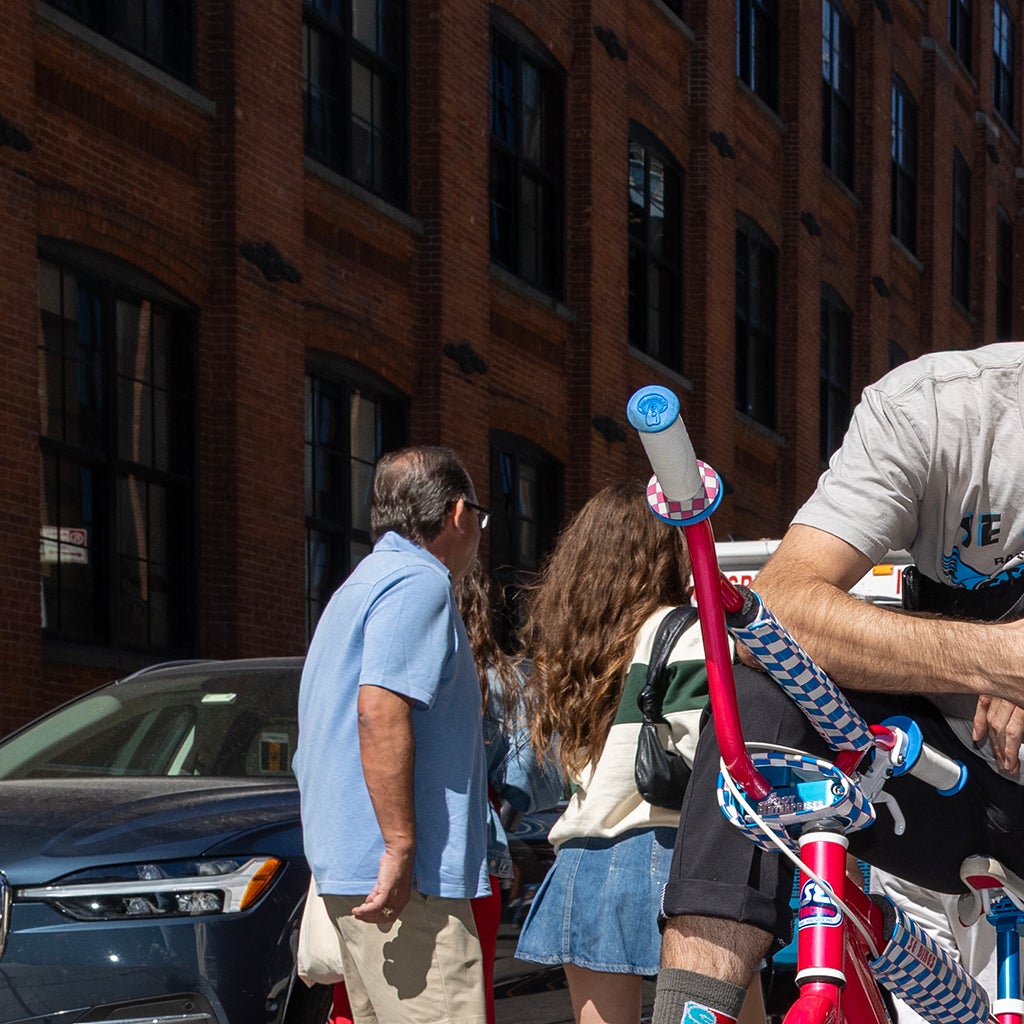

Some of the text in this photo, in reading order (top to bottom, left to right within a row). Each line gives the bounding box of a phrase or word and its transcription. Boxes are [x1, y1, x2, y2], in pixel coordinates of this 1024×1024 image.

[960, 512, 1001, 548] SE
[907, 937, 937, 969] SE BIKES
